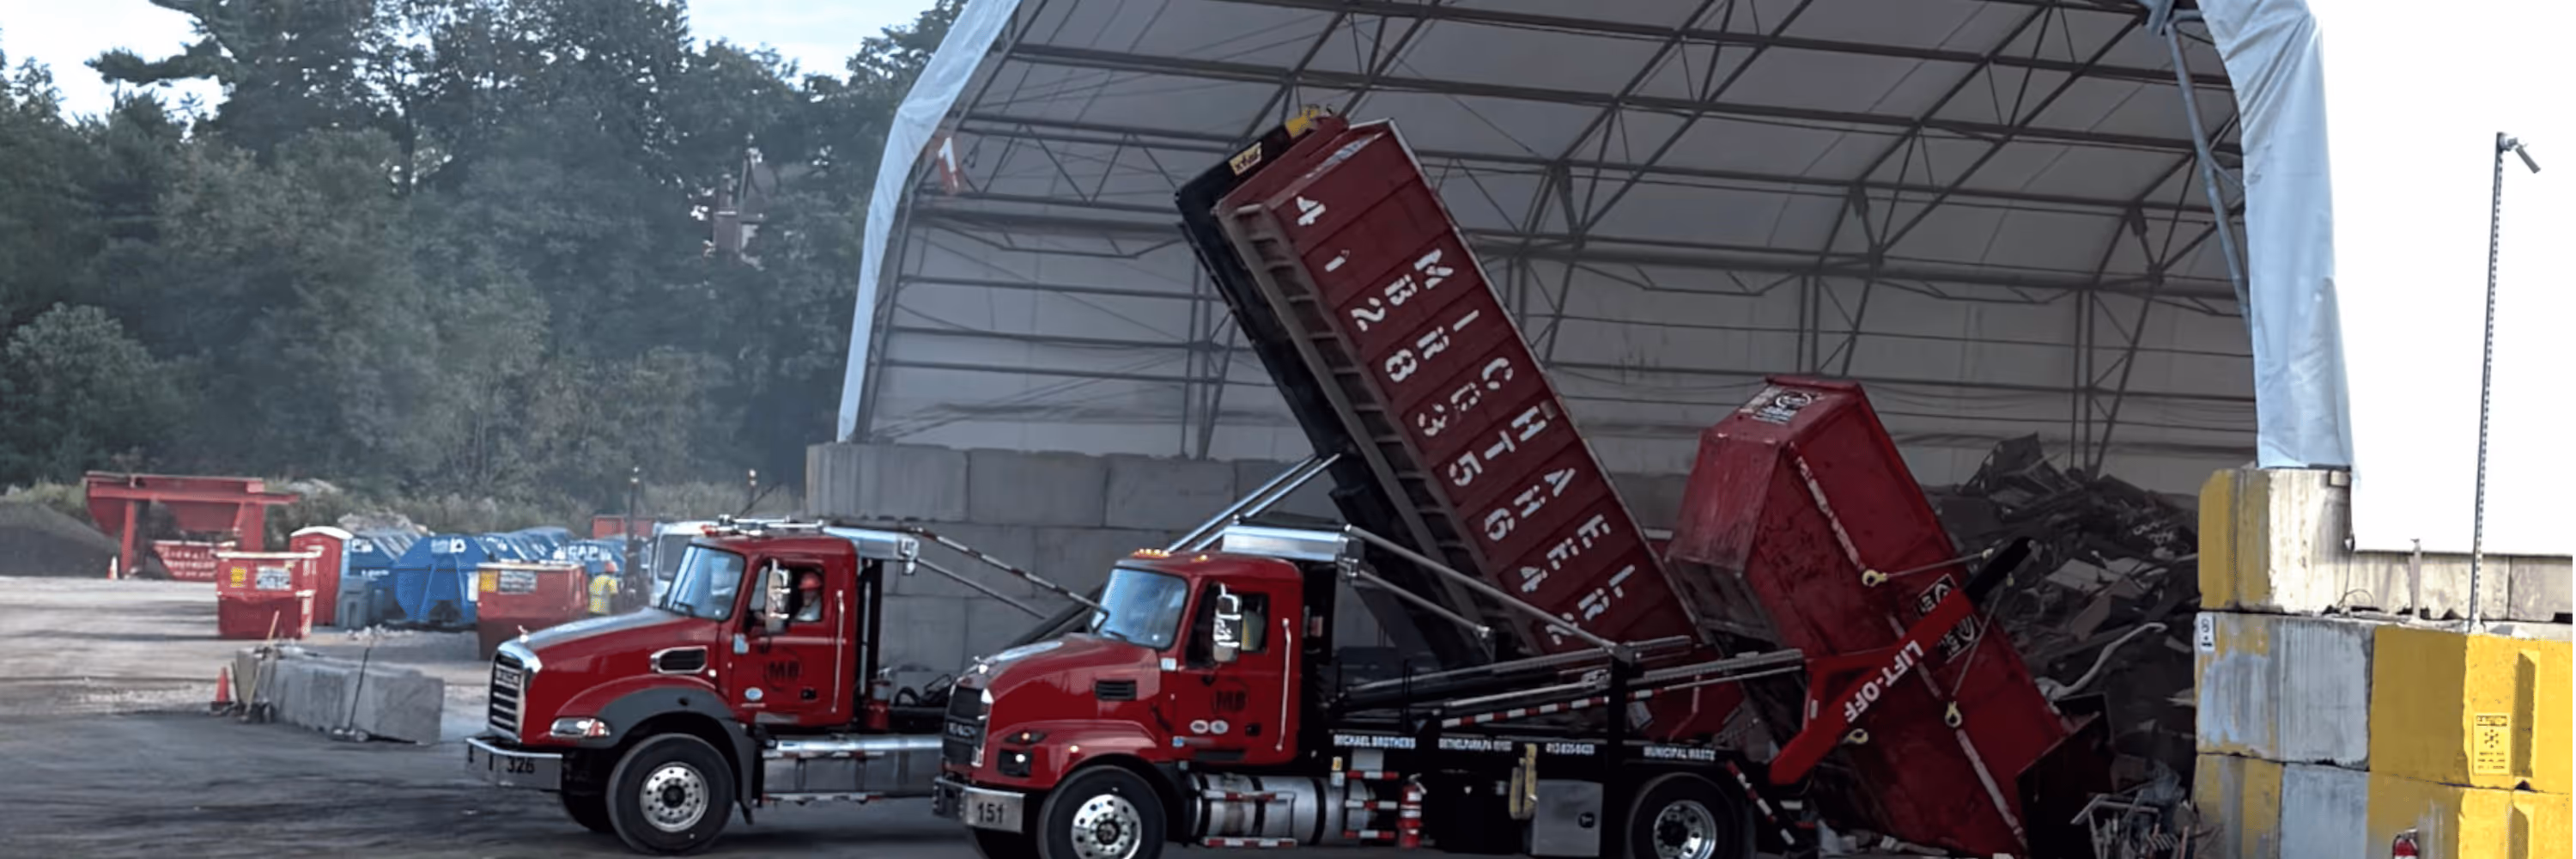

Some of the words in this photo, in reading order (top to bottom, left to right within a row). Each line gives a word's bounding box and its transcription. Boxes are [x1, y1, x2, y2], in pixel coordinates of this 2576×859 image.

[1384, 274, 1611, 621] BROTHER
[1844, 639, 1924, 723] LIFT-OFF
[507, 756, 535, 773] 326
[978, 803, 1004, 825] 151
